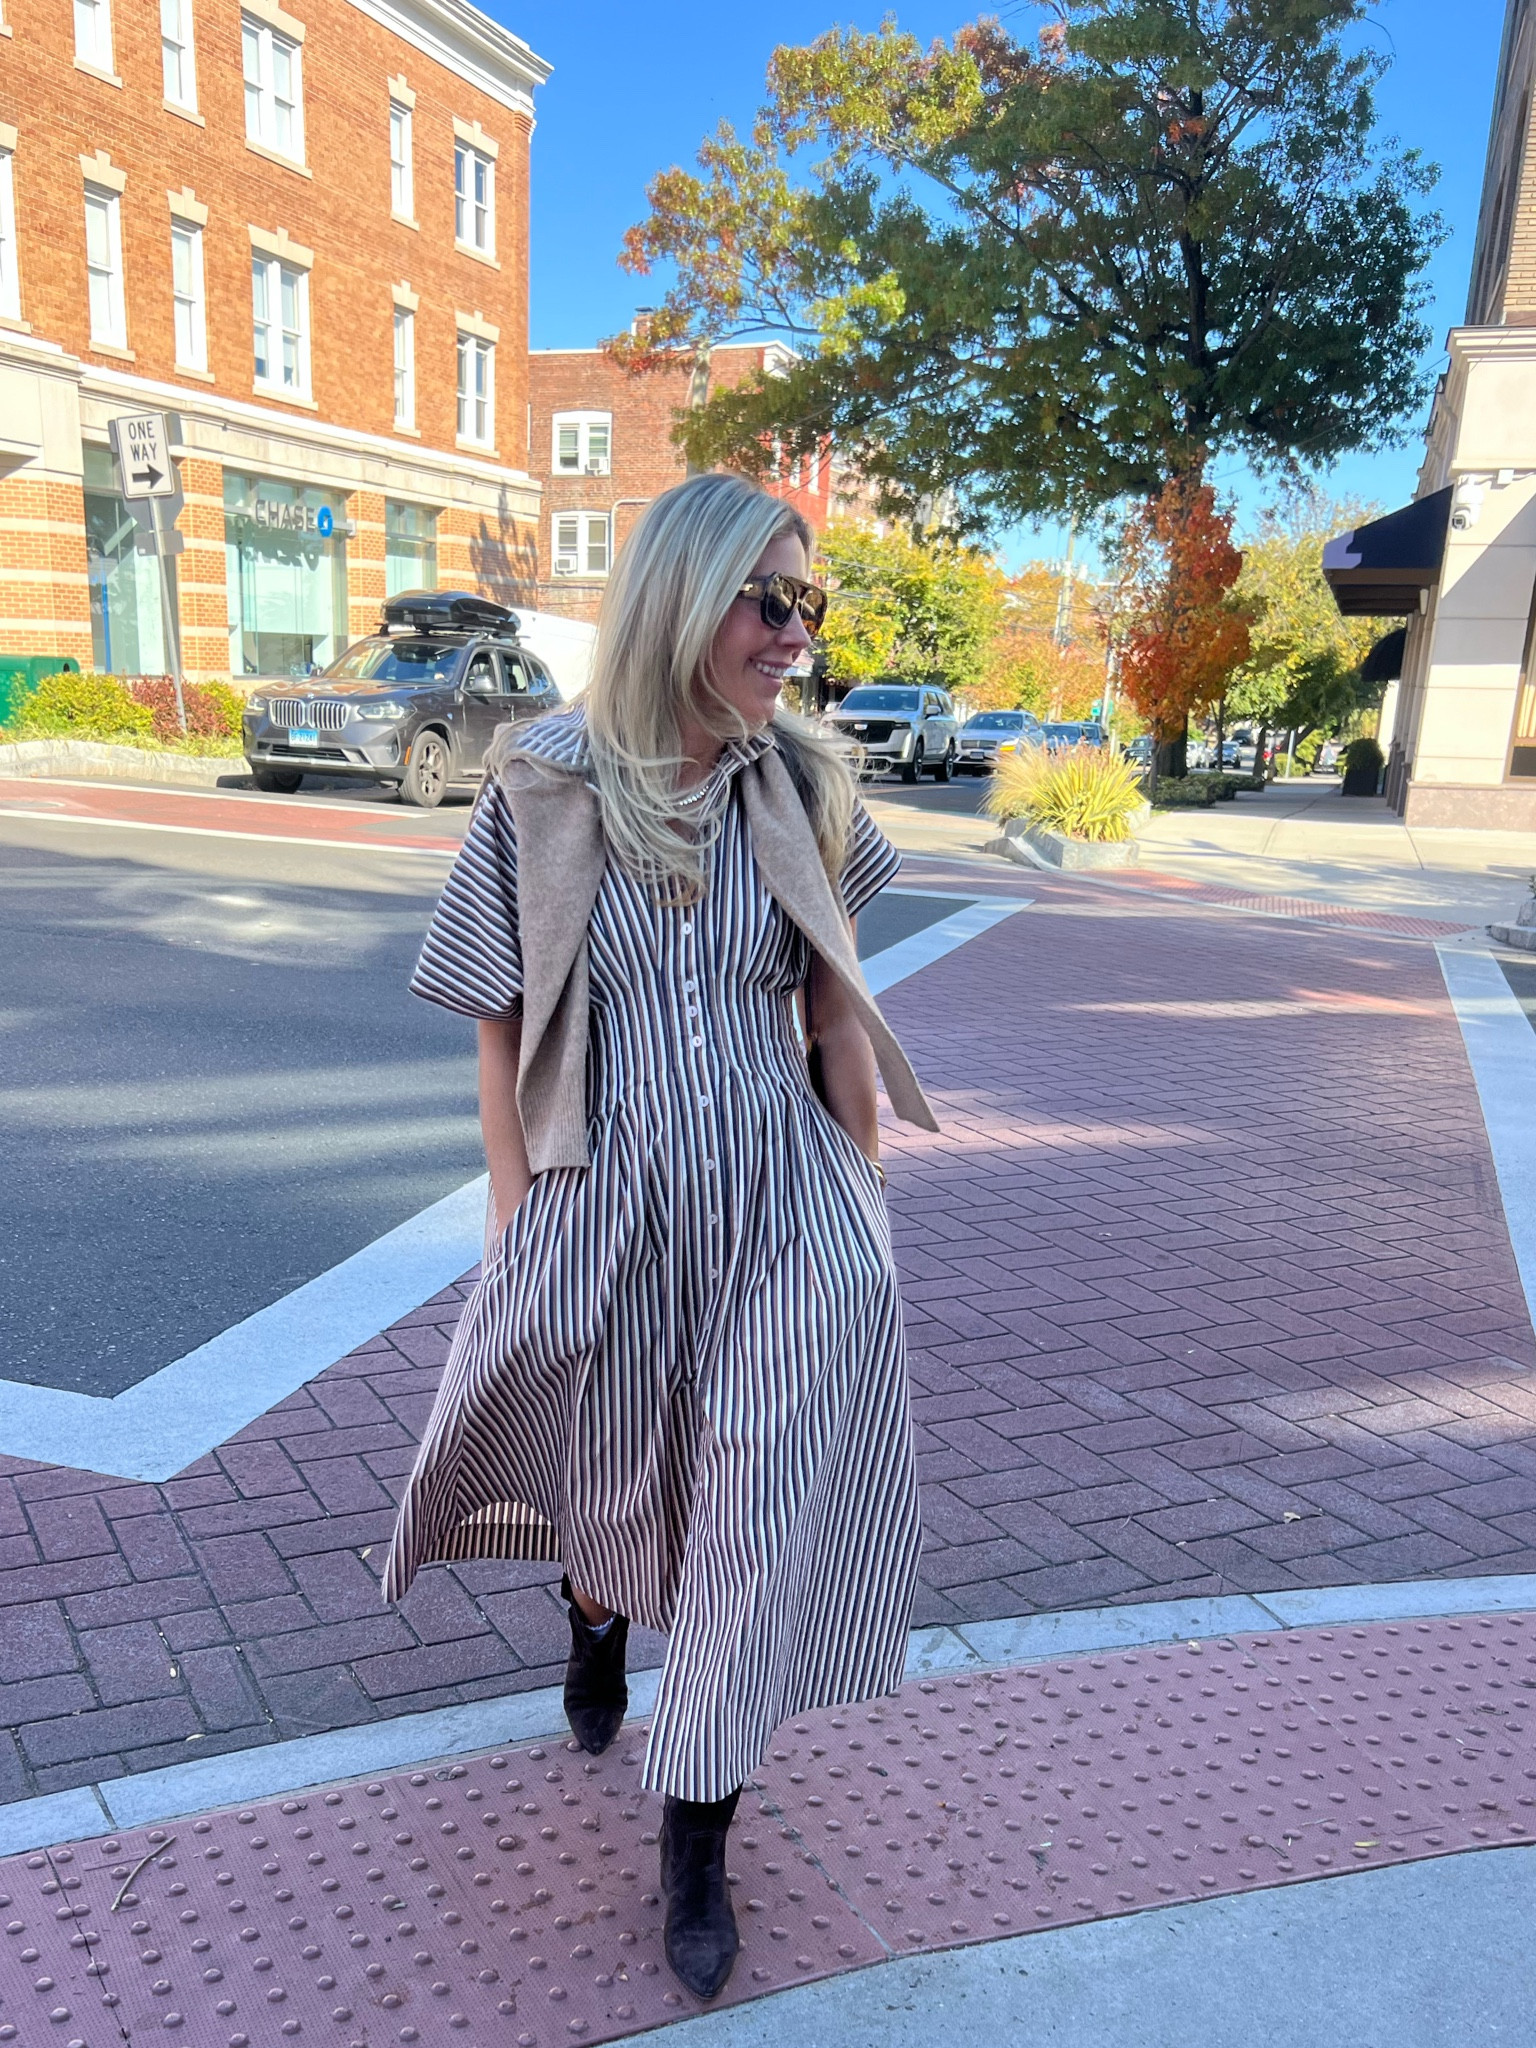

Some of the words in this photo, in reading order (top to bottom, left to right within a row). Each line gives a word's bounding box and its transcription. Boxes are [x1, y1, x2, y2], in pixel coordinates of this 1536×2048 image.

[128, 421, 155, 440] ONE
[130, 443, 157, 462] WAY
[255, 499, 317, 533] CHASE
